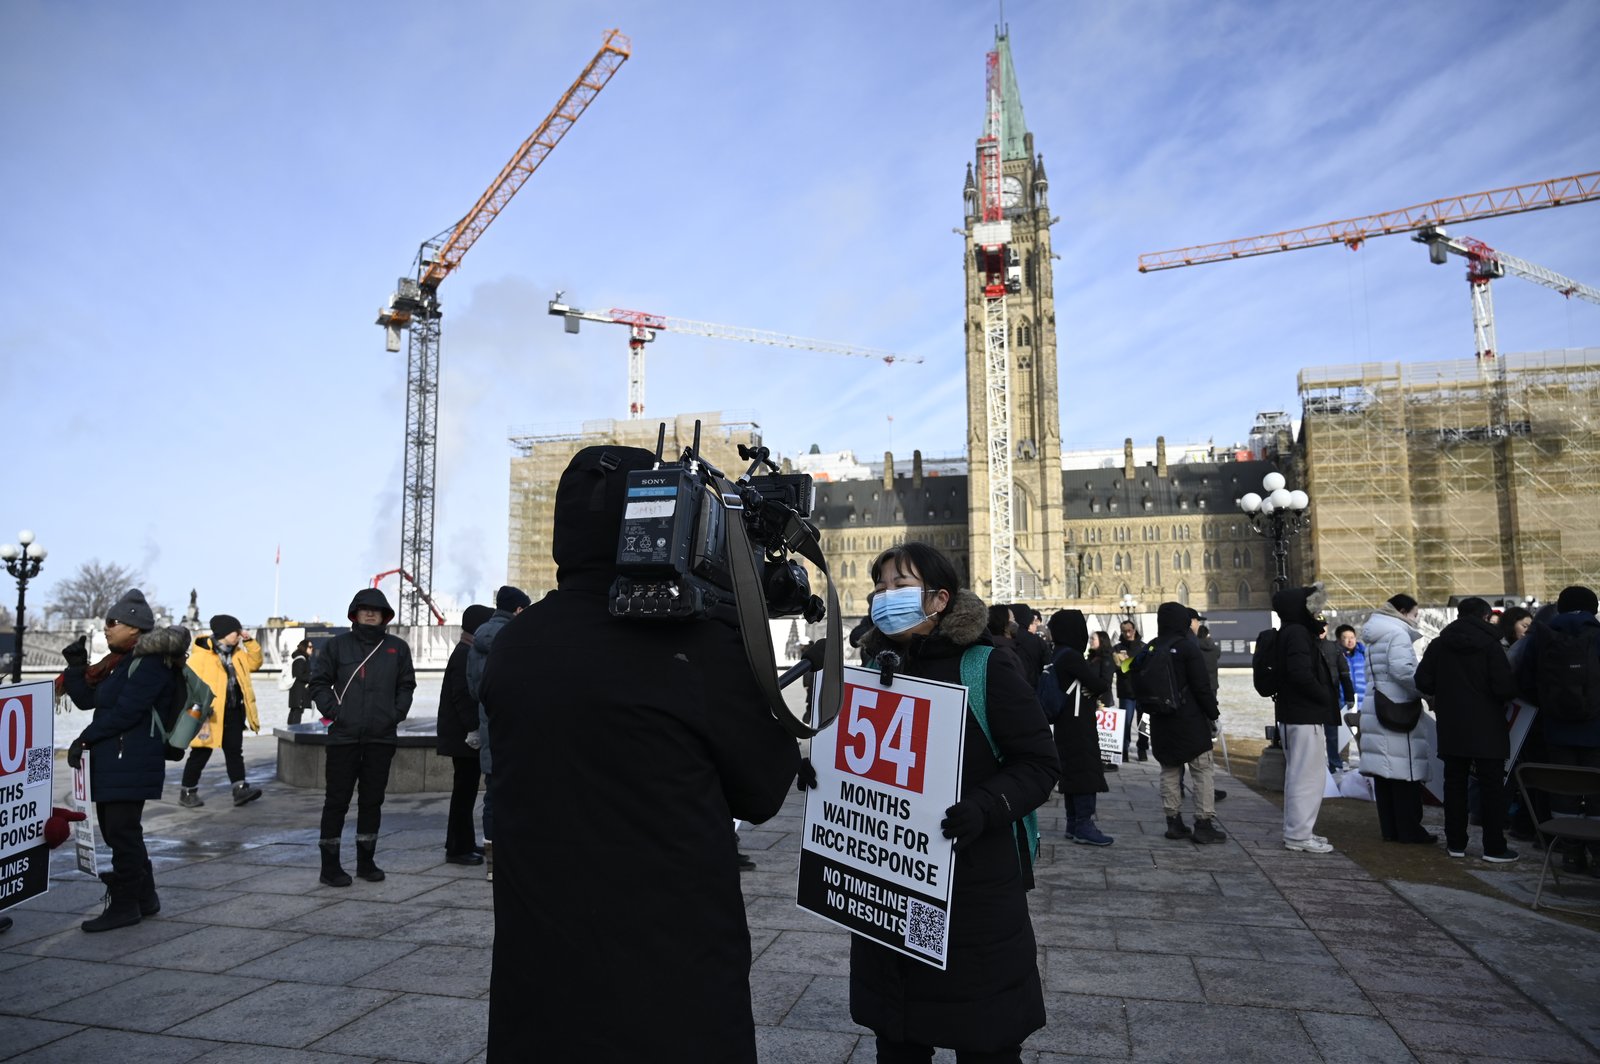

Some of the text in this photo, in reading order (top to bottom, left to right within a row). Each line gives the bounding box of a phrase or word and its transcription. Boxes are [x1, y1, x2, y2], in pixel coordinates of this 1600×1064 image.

[844, 687, 917, 787] 54
[1095, 710, 1115, 731] 28
[12, 801, 37, 824] FOR
[840, 781, 910, 820] MONTHS
[1, 820, 44, 850] PONSE
[823, 801, 929, 855] WAITING FOR
[811, 823, 939, 887] IRCC RESPONSE
[823, 866, 909, 913] NO TIMELINE
[827, 889, 906, 936] NO RESULTS
